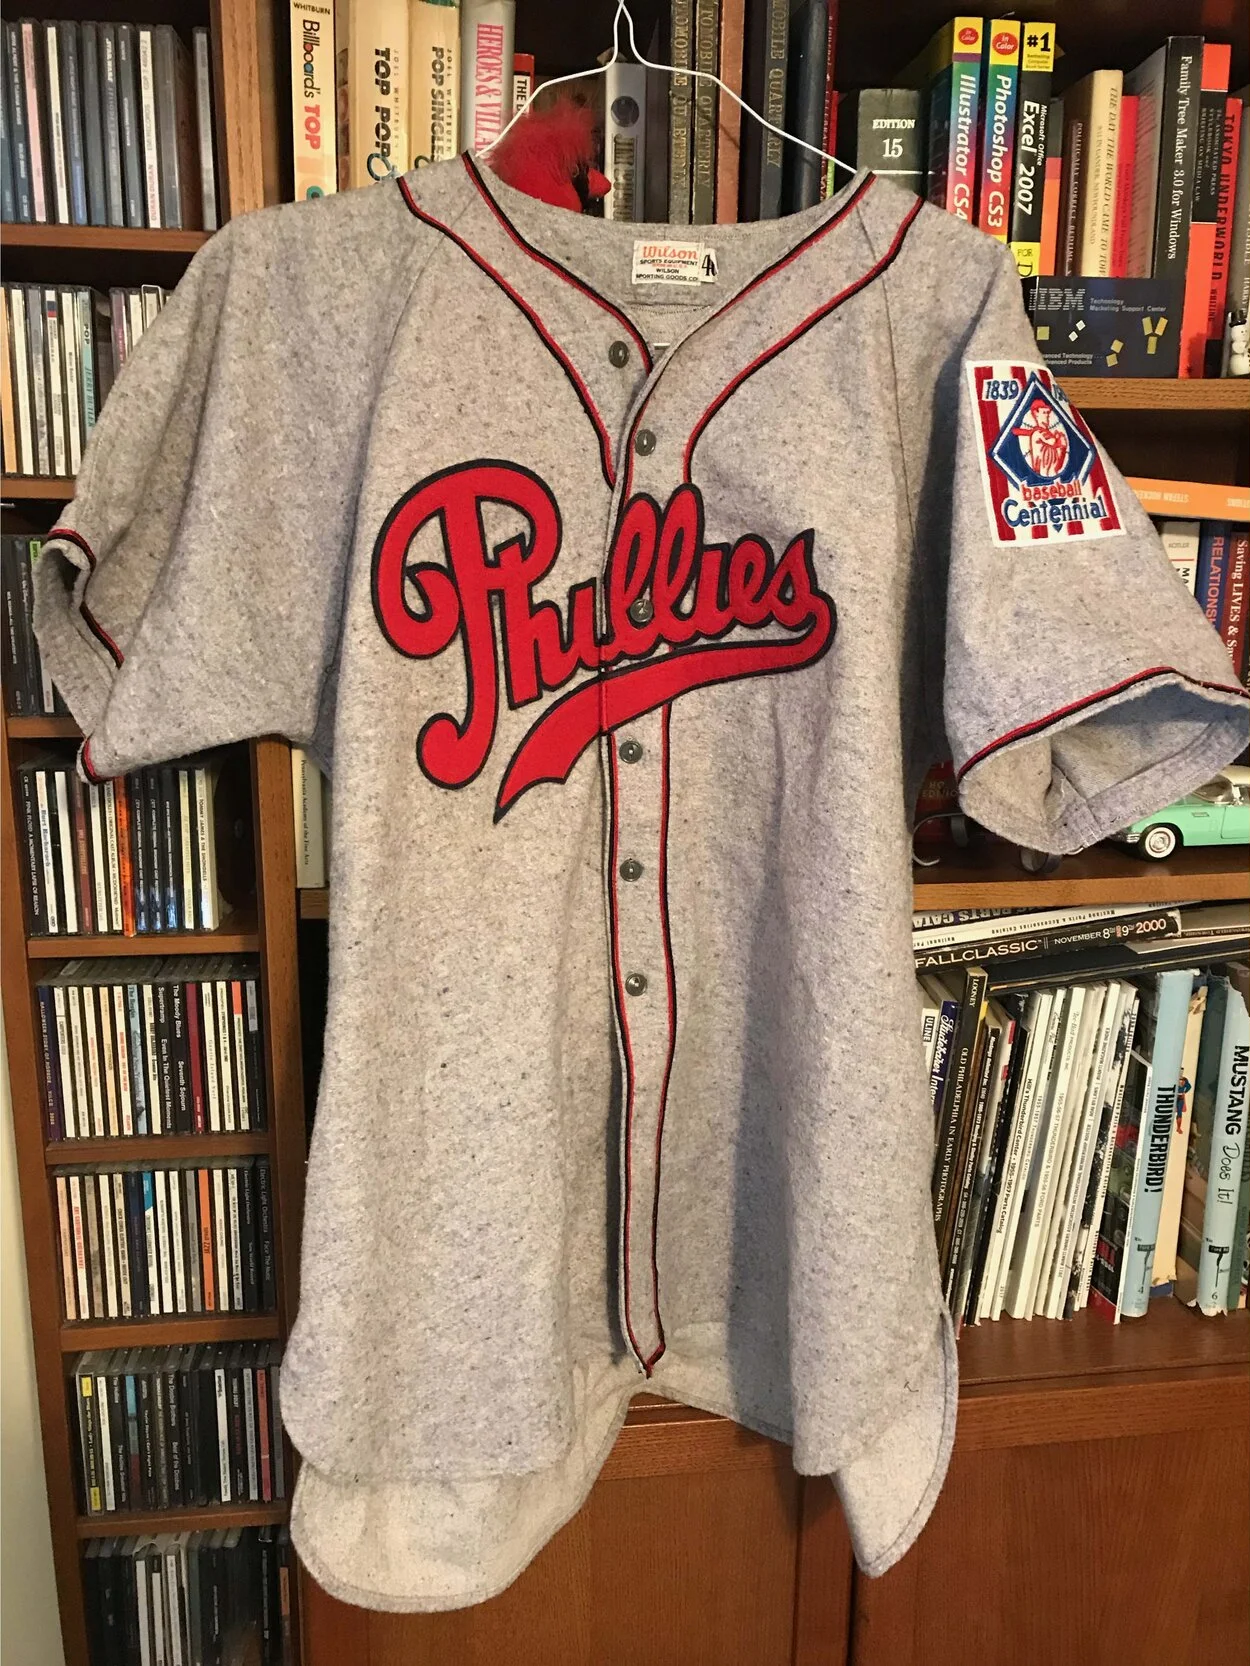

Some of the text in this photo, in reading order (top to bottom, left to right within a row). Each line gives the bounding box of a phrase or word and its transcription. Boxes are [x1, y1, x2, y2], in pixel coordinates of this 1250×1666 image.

[374, 48, 391, 95] TOP
[432, 47, 444, 86] POP
[475, 23, 504, 97] HEROES &
[996, 42, 1015, 50] Color
[1027, 31, 1051, 52] #1
[303, 19, 321, 150] Billboard's TOP
[872, 118, 915, 130] EDITION
[882, 137, 904, 158] 15
[953, 74, 976, 221] Illustrator CS4
[987, 74, 1012, 228] Photoshop CS3
[1036, 104, 1048, 166] Microsoft Office
[1017, 100, 1040, 215] Excel 2007
[1098, 87, 1118, 276] THE DAY THE WORLD CAME TO TOW
[1167, 55, 1193, 259] Family Tree Maker 3.0 for Windows
[1211, 113, 1237, 281] TOKYO UNDERWORLD
[643, 246, 698, 260] Wilson
[1038, 288, 1086, 310] IBM
[85, 367, 96, 428] JERRY BUTLER
[985, 380, 1020, 400] 1839
[1003, 495, 1107, 527] Centennial
[1021, 481, 1082, 500] baseball
[1205, 536, 1225, 626] RELATIONS
[1227, 539, 1249, 636] Saving LIVES &
[371, 458, 837, 806] Phillies
[300, 759, 310, 797] Pennsylvania
[40, 809, 52, 867] Burt Bacharach
[1054, 931, 1102, 945] NOVEMBER
[1135, 918, 1167, 934] 2000
[39, 1002, 47, 1034] HALLOWEEN
[158, 987, 166, 1023] Supertramp
[163, 1075, 171, 1100] Quietest
[923, 1017, 935, 1042] ULINE
[932, 1014, 955, 1073] Studebaker
[172, 998, 181, 1019] Moody
[179, 1087, 187, 1111] Sojourn
[934, 978, 980, 1222] LOONEY OLD PHILADELPHIA IN EARLY PHOTOGRAPHS
[1216, 1045, 1250, 1205] MUSTANG Does It!
[995, 1078, 1033, 1234] Hill's Thunderbird Center 1955-1957 Parts Catalog
[1144, 1085, 1176, 1193] THUNDERBIRD!
